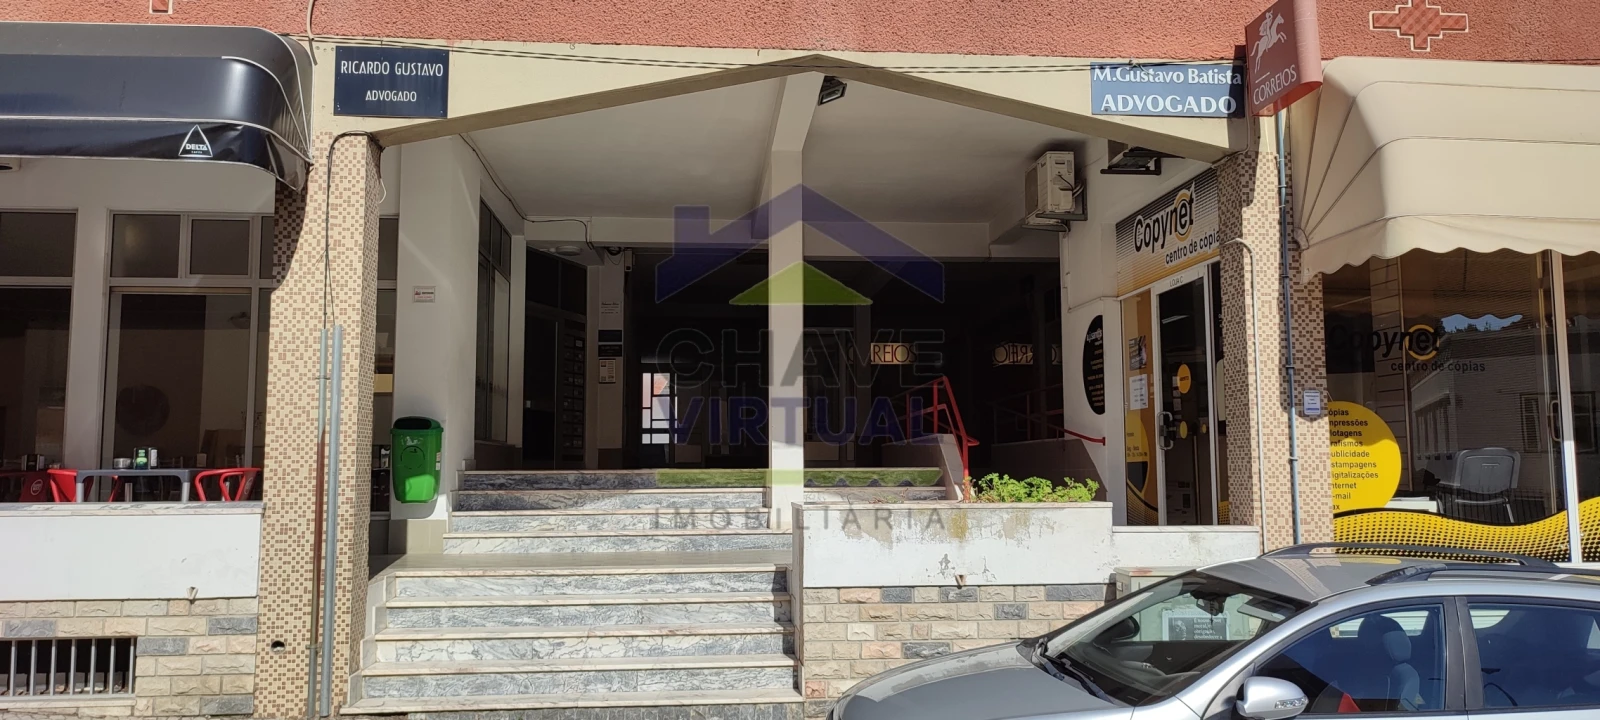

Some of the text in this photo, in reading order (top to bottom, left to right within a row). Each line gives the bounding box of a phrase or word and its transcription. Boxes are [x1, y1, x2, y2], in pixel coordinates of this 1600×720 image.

[340, 60, 444, 77] RICARDO GUSTAVO
[1093, 65, 1242, 85] M.Gustavo Batista
[1253, 64, 1297, 105] CORREIOS
[365, 89, 417, 102] ADVOGADO
[1100, 93, 1237, 114] ADVOGADO
[185, 143, 208, 151] DELTA
[1134, 190, 1195, 253] Copynet
[1165, 229, 1220, 265] centro de cópia
[1328, 322, 1440, 358] Copynet
[847, 344, 917, 363] REIOS
[1390, 361, 1485, 374] centro de cópias
[1328, 408, 1349, 417] ópias
[1329, 419, 1368, 428] mpressões
[1330, 429, 1362, 438] lotagens
[1331, 450, 1370, 458] ublicidade
[1331, 461, 1377, 470] stampagens
[1332, 471, 1379, 480] igitalizações
